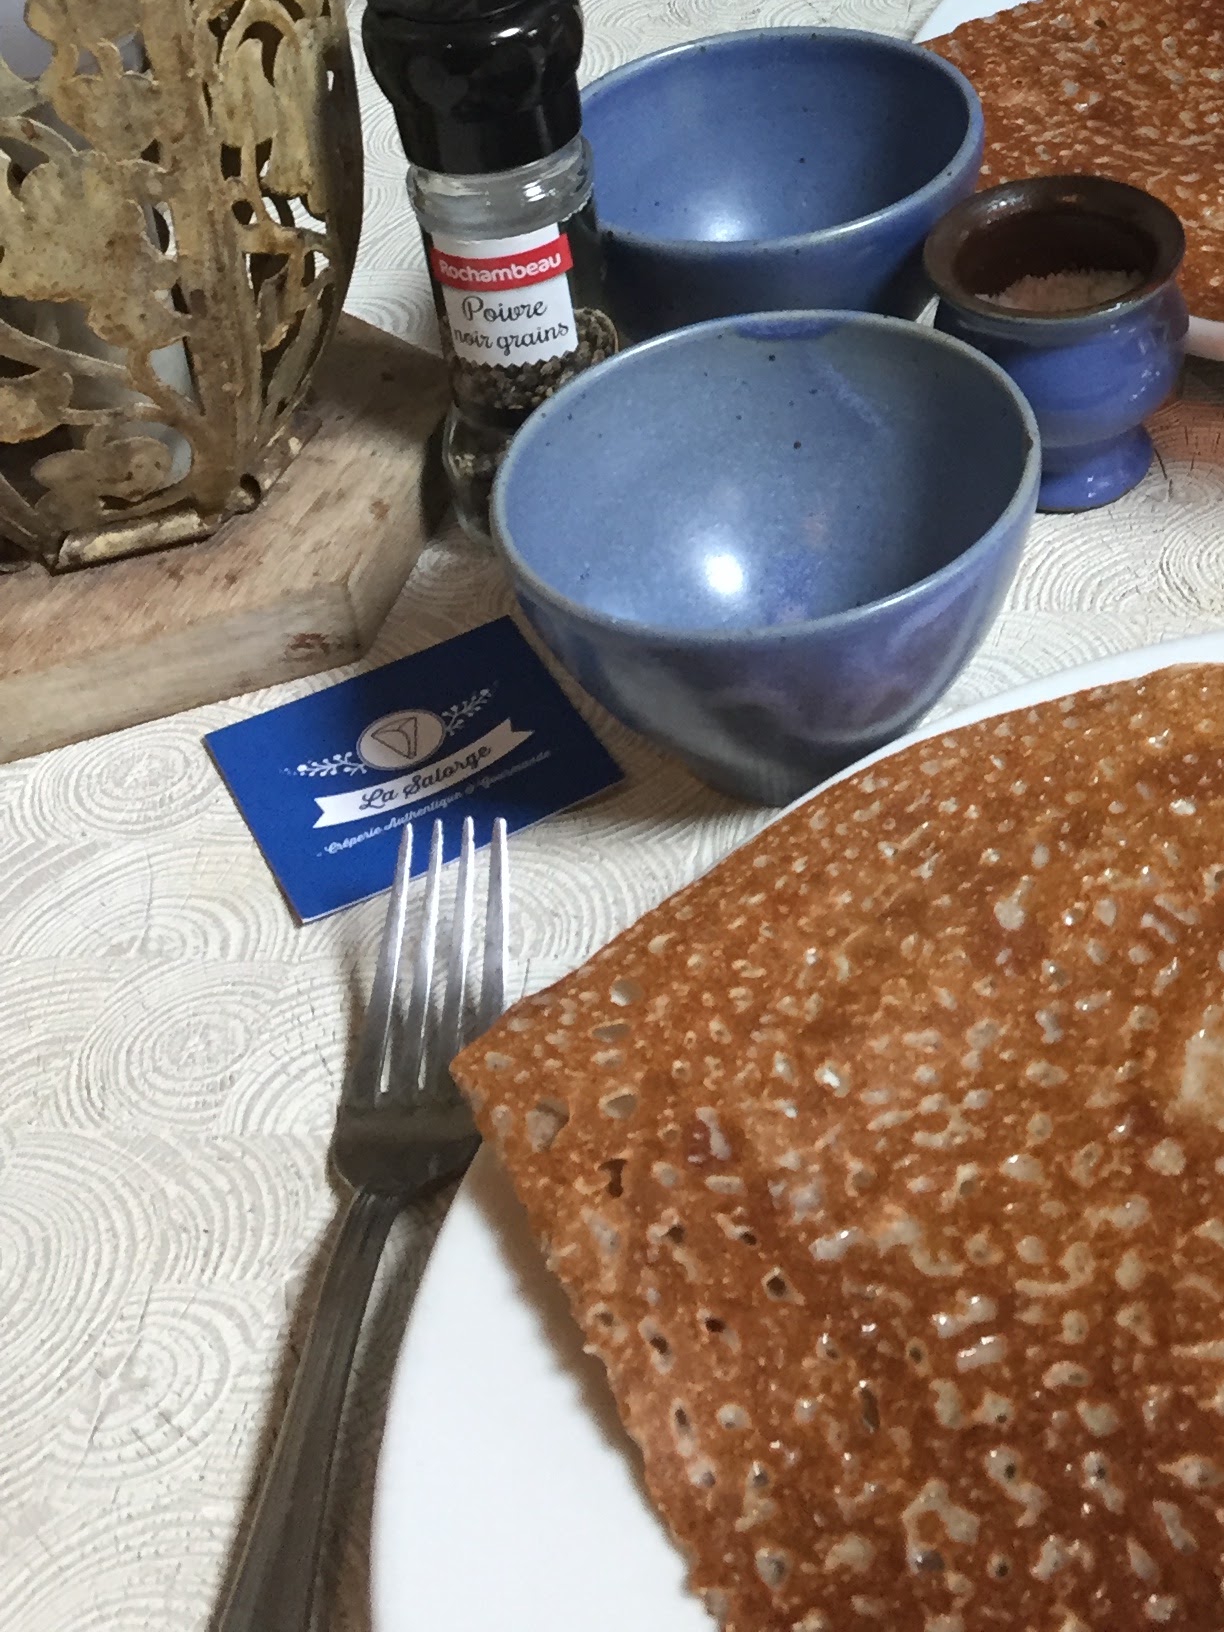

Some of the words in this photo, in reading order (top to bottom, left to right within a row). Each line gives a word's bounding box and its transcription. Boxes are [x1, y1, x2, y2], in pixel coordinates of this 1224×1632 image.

[439, 253, 561, 282] Rochambeau
[462, 296, 547, 323] Poivre
[454, 329, 493, 350] noir
[497, 323, 568, 356] grains
[359, 788, 398, 810] La
